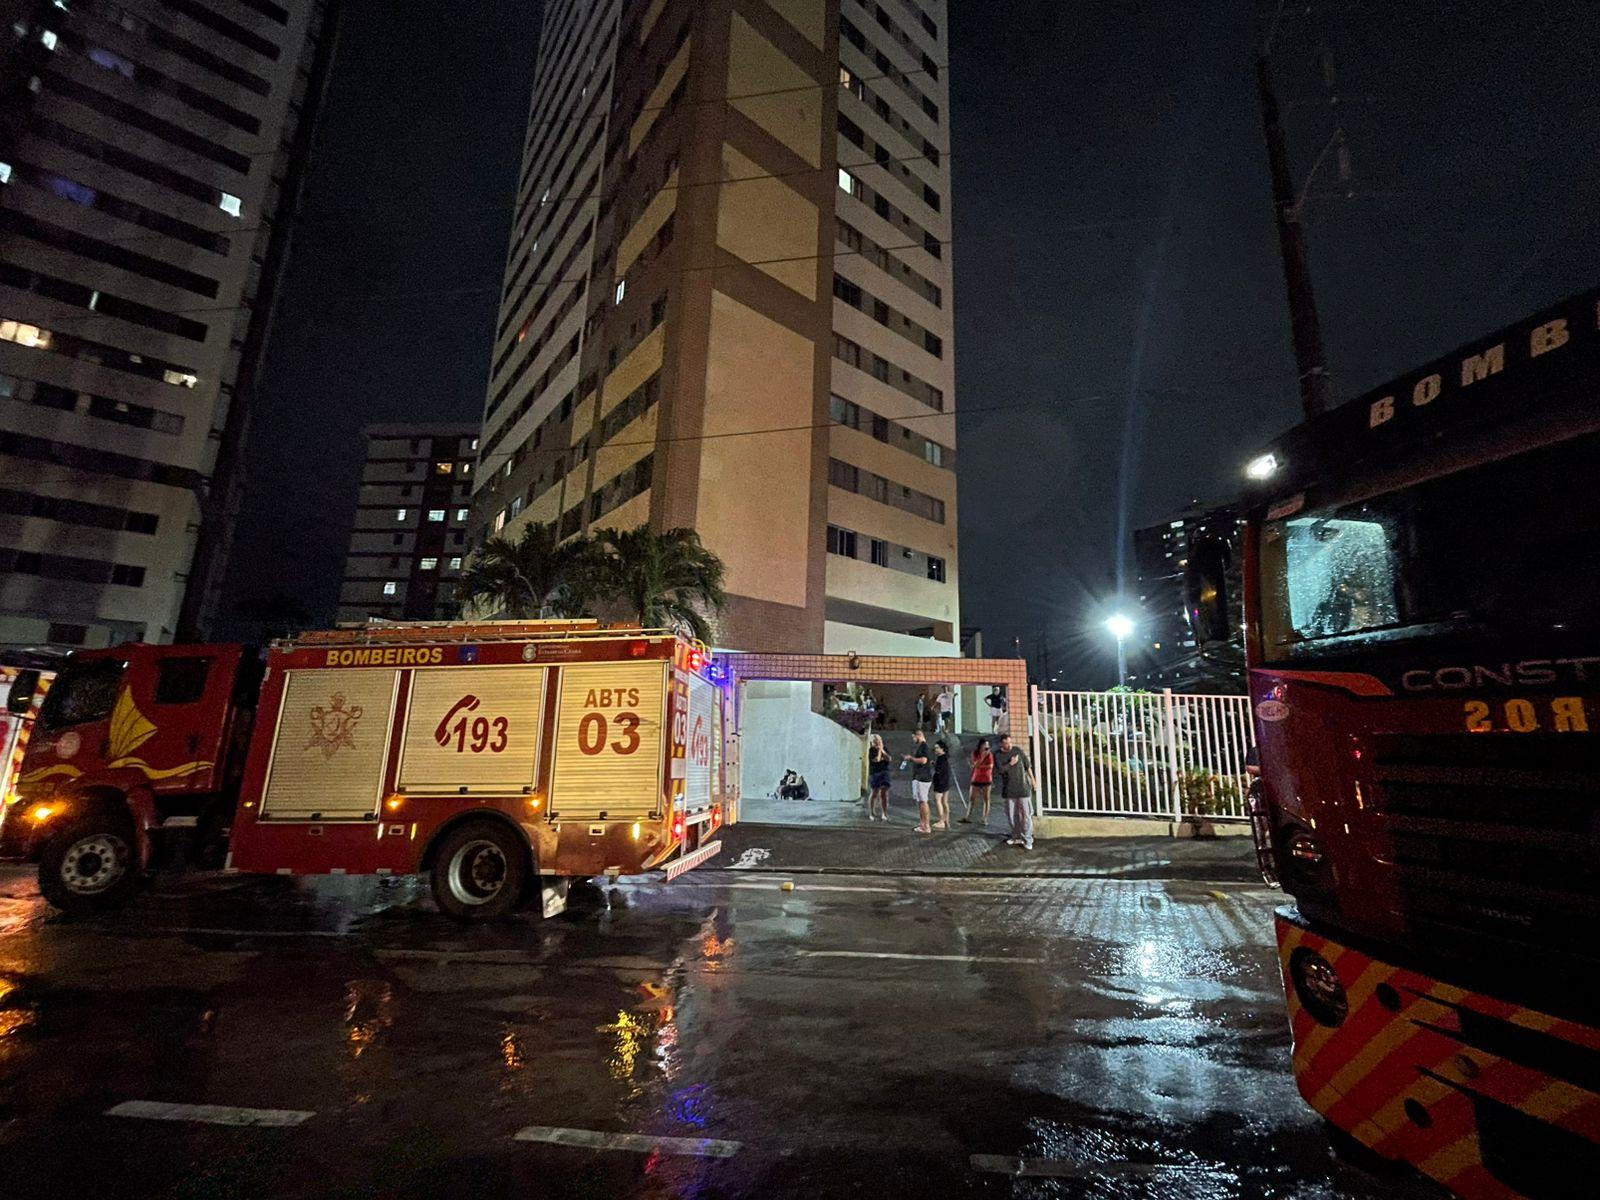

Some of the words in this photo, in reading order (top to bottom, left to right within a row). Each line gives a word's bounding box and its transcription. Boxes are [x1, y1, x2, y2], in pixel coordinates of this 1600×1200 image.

[1369, 300, 1600, 429] BOMB
[326, 648, 443, 665] BOMBEIROS
[584, 688, 639, 707] ABTS
[453, 716, 508, 752] 193
[578, 712, 640, 755] 03
[675, 711, 687, 745] 03
